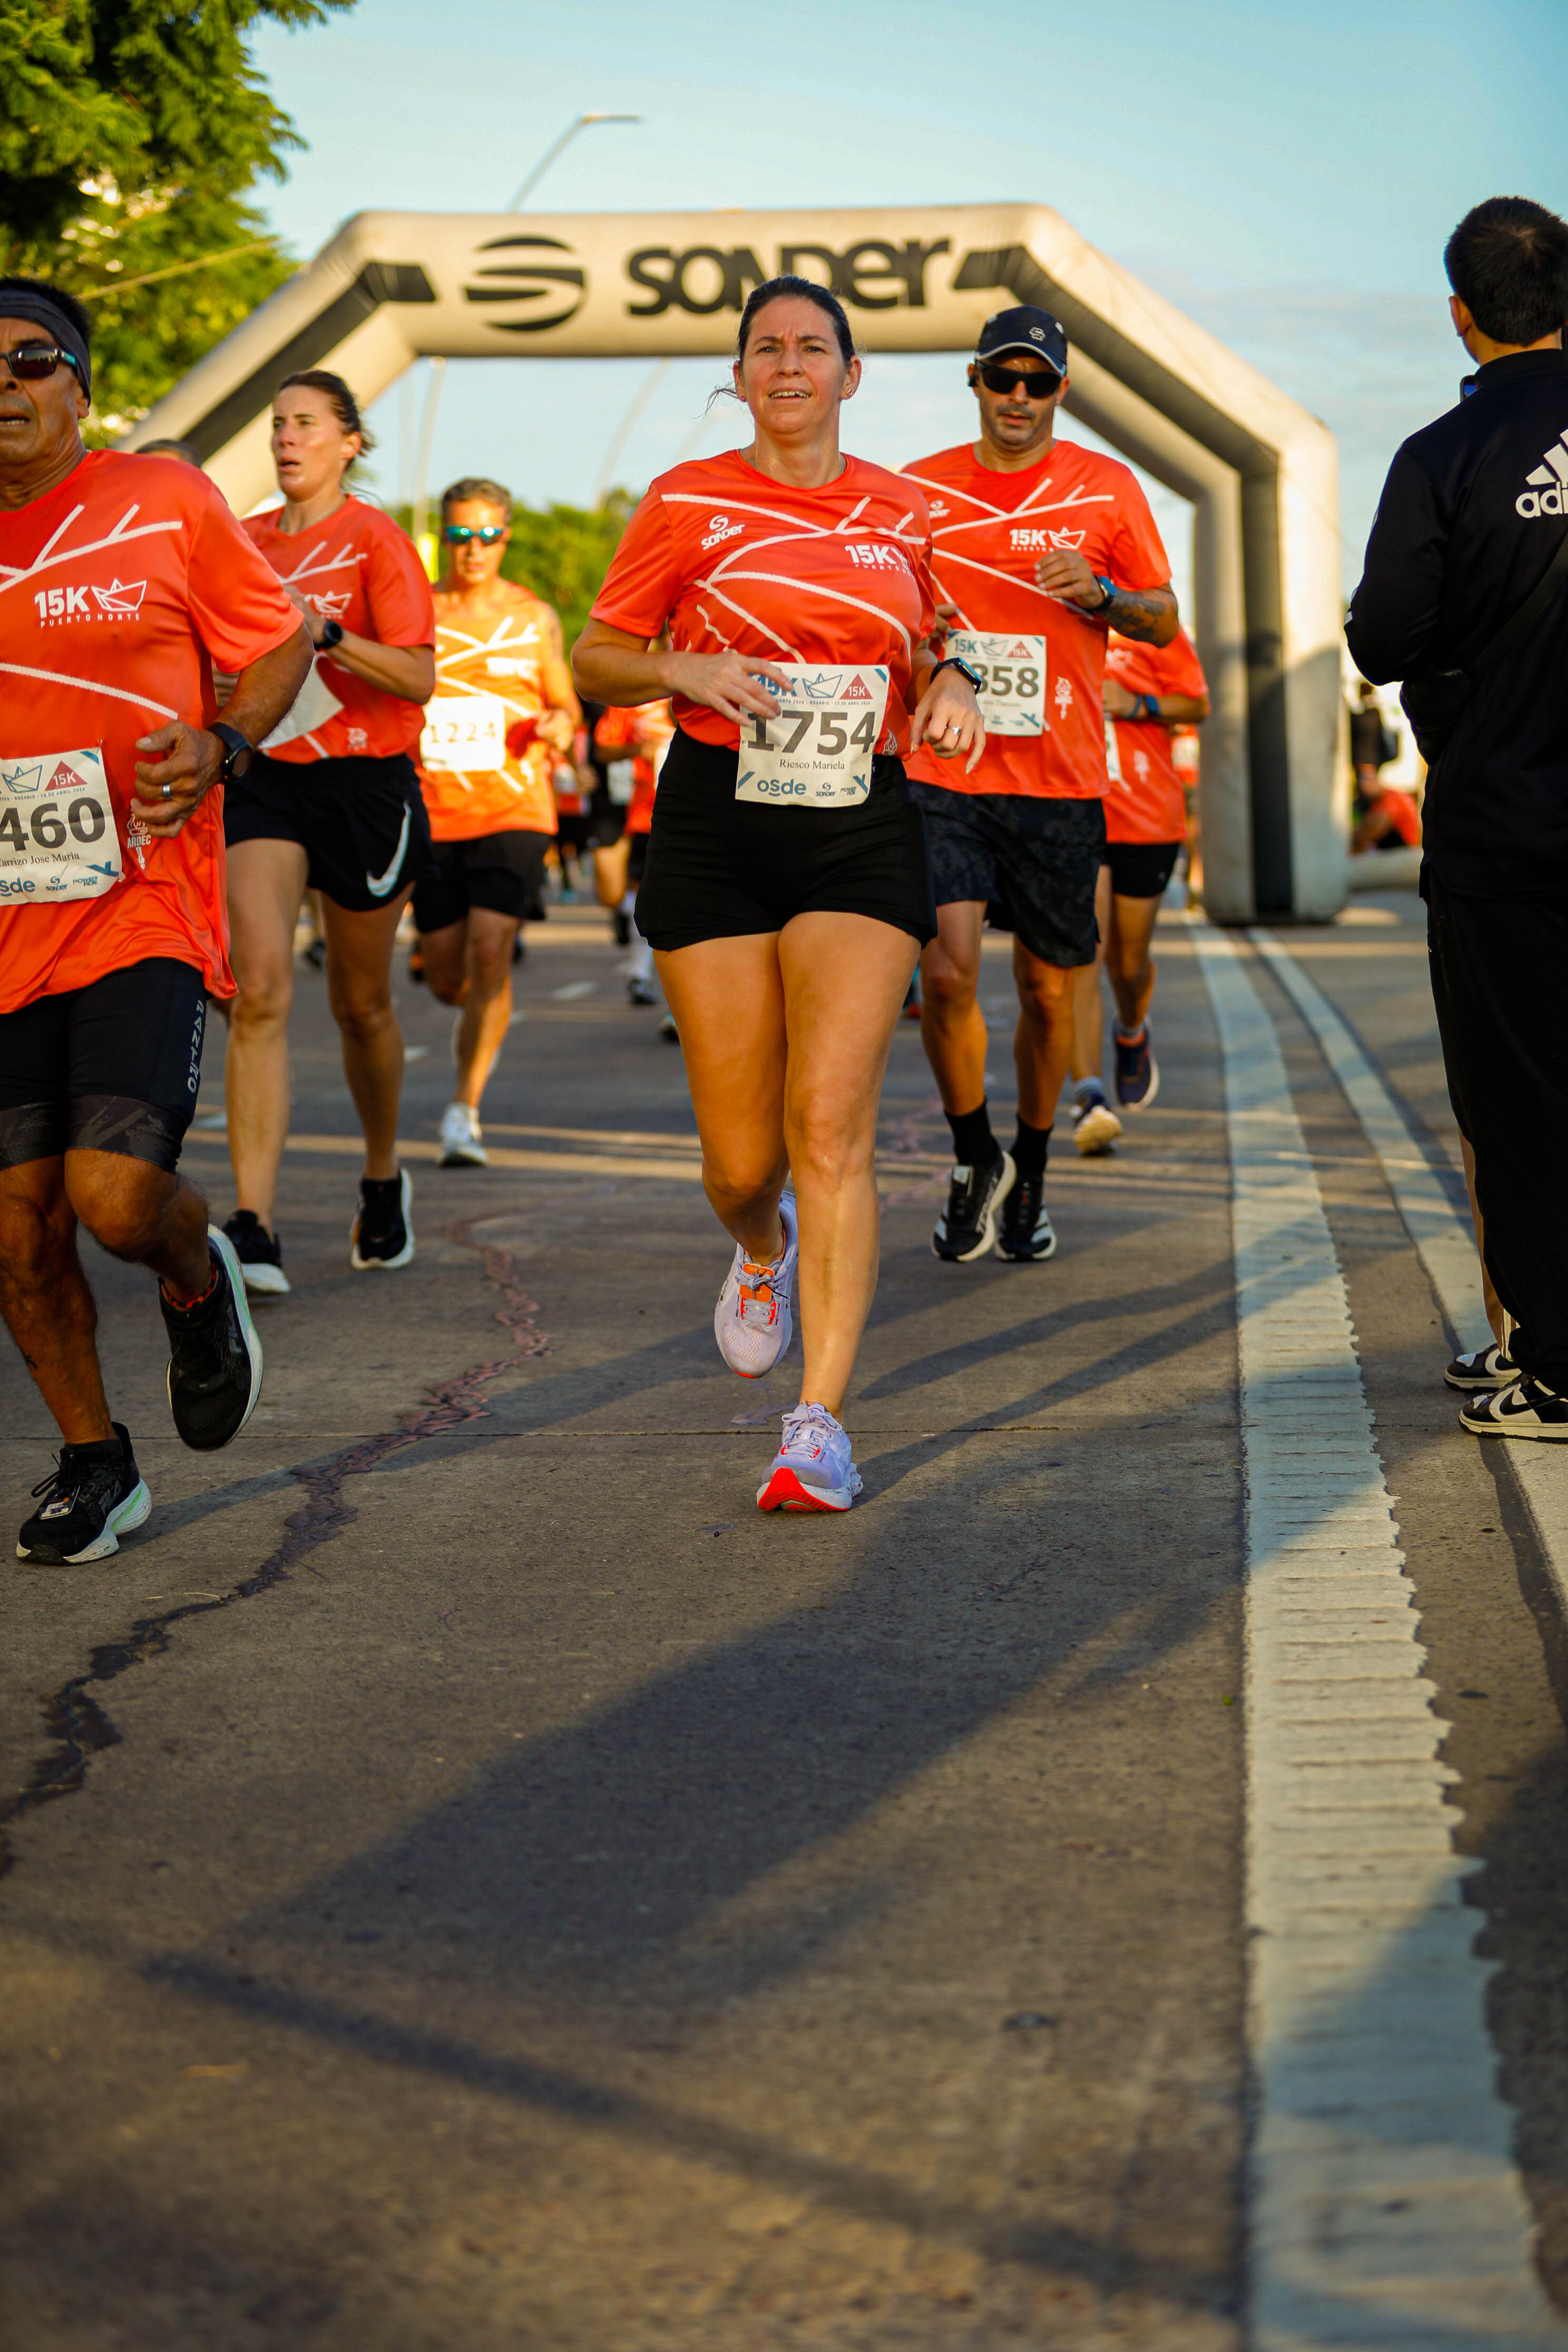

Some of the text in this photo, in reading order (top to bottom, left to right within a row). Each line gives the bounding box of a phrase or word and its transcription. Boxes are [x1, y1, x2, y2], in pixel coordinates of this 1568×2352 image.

[1010, 528, 1047, 546] 15K
[844, 544, 897, 564] 15K
[34, 585, 90, 619] 15K
[40, 612, 140, 629] PUERTO NORTE
[954, 639, 977, 654] 15K
[848, 685, 866, 697] 15K
[429, 722, 496, 744] 1224
[747, 710, 876, 756] 1754
[779, 759, 845, 770] Riesco Mariela
[53, 771, 76, 787] 15K
[757, 778, 807, 797] osde
[0, 796, 105, 852] 460
[127, 835, 151, 849] ARDEC
[31, 855, 50, 865] Jose
[52, 851, 80, 862] Maria
